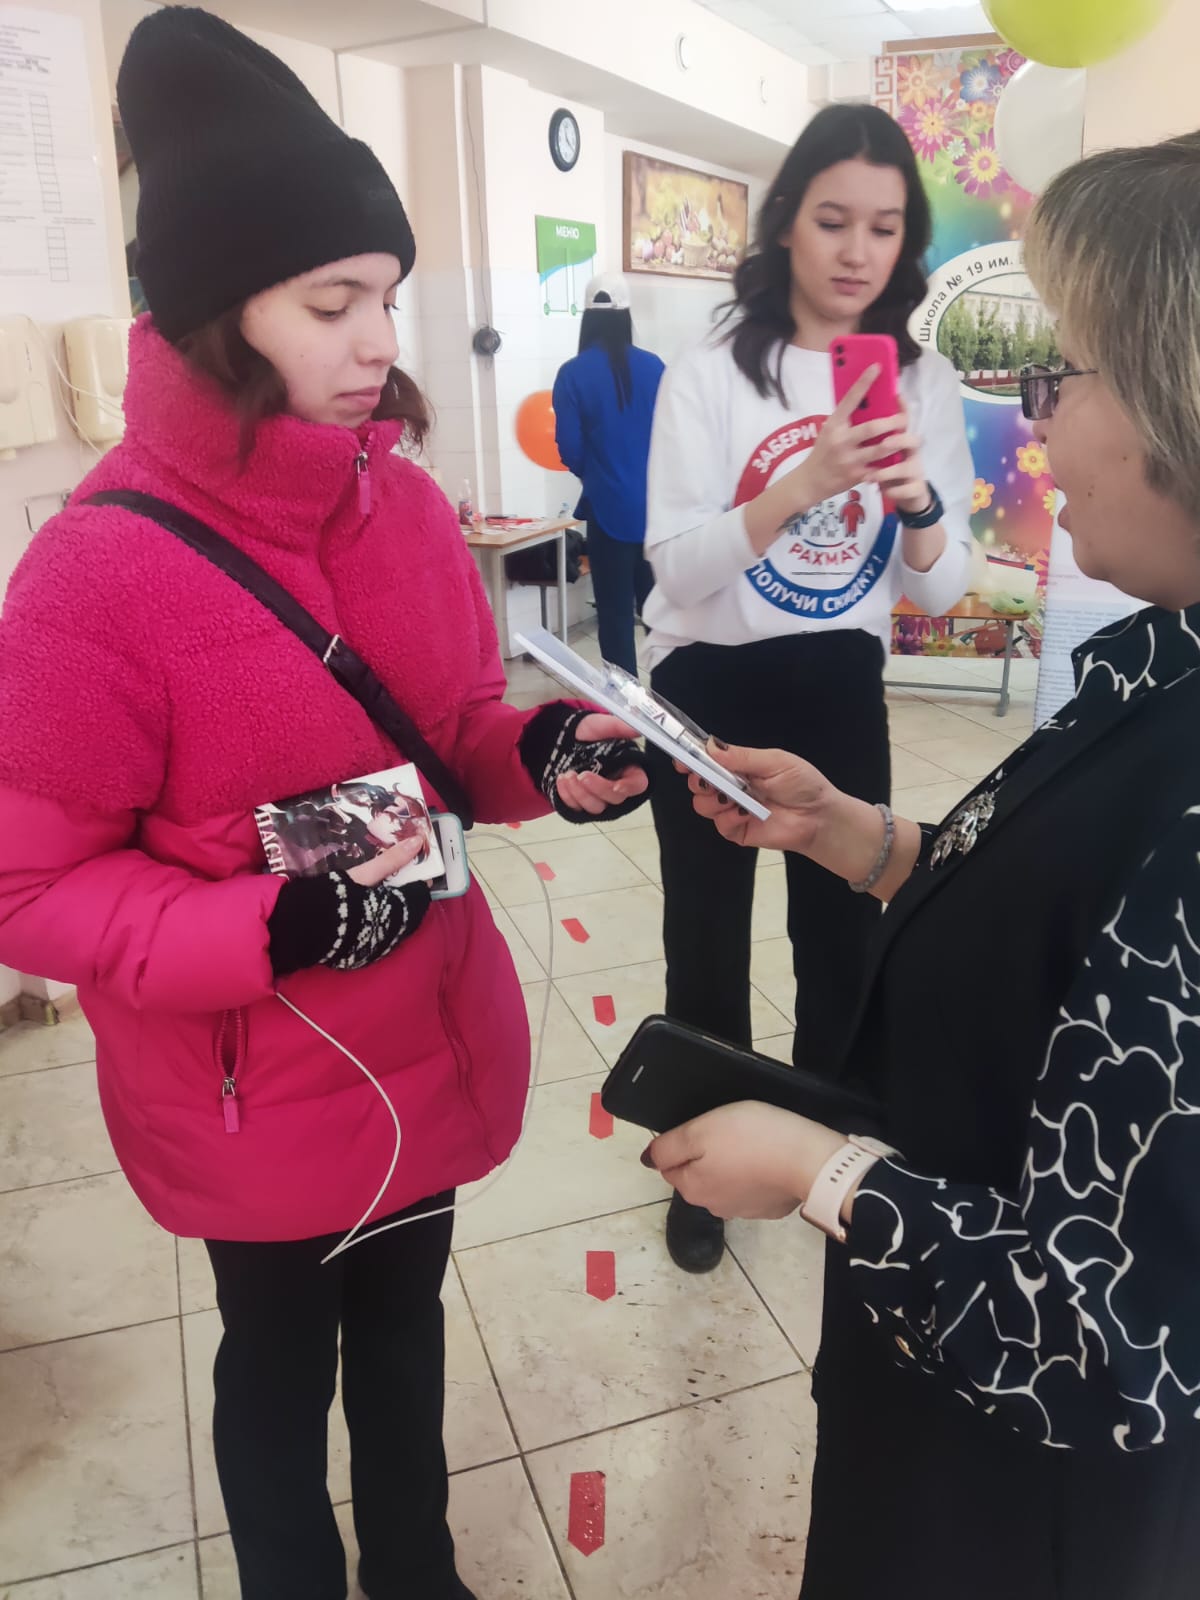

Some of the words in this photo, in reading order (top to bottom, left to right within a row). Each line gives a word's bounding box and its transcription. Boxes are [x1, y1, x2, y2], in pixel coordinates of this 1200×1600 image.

[556, 224, 580, 239] МЕНЮ
[919, 291, 947, 342] Школа
[946, 274, 962, 290] №
[966, 261, 983, 277] 19
[988, 256, 1014, 270] им.
[752, 423, 818, 473] ЗАБЕРИ
[788, 542, 862, 566] РАХМАТ
